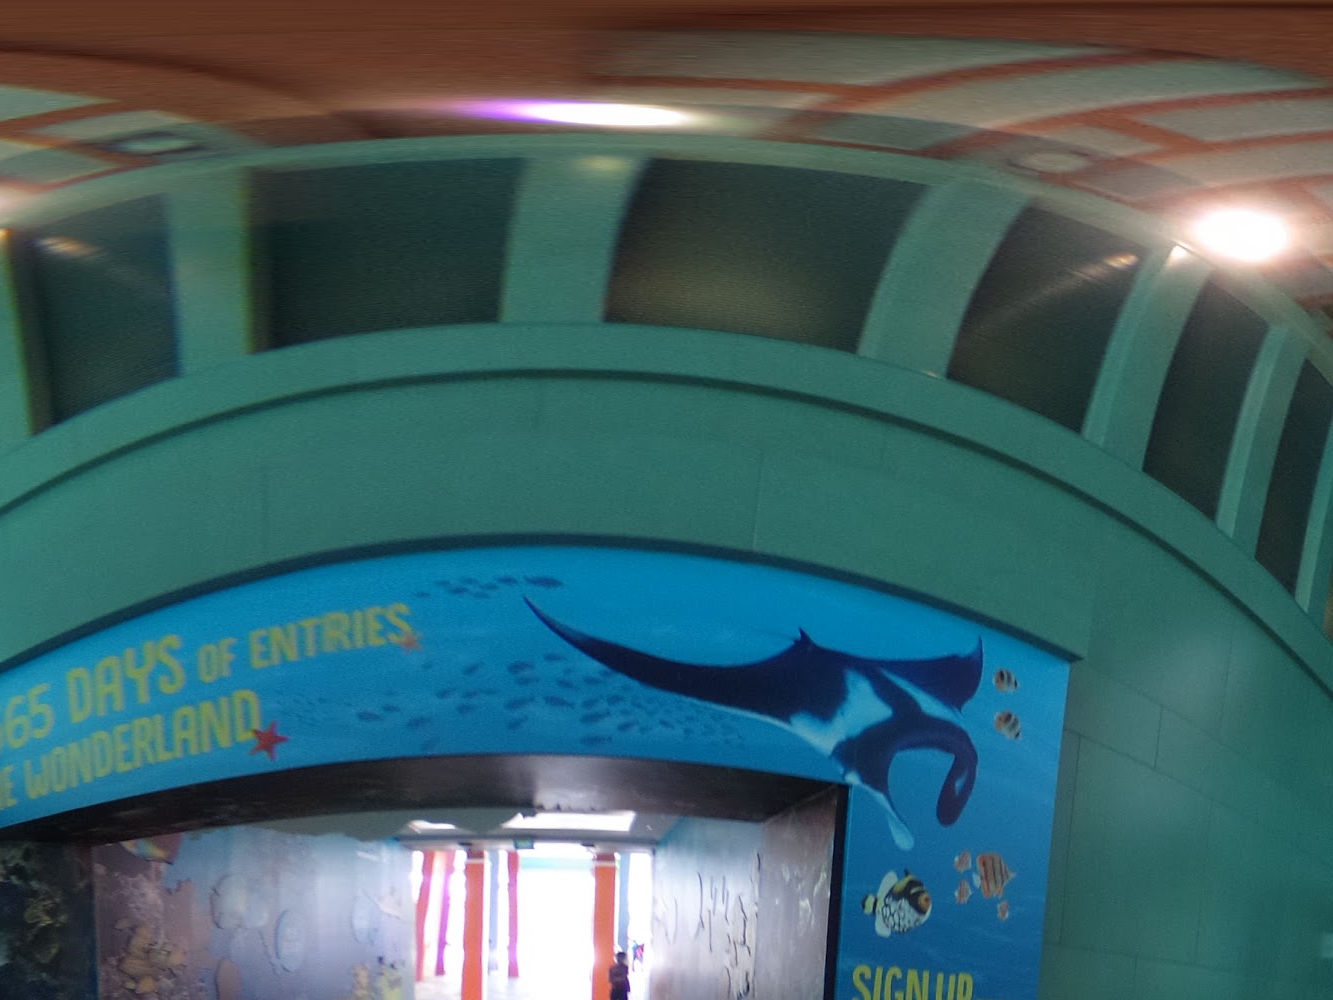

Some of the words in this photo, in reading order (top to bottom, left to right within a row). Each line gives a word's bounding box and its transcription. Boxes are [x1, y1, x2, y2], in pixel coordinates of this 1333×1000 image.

[66, 634, 185, 723] DAYS
[197, 637, 237, 684] OF
[248, 602, 414, 670] ENTRIES
[23, 689, 262, 800] WONDERLAND
